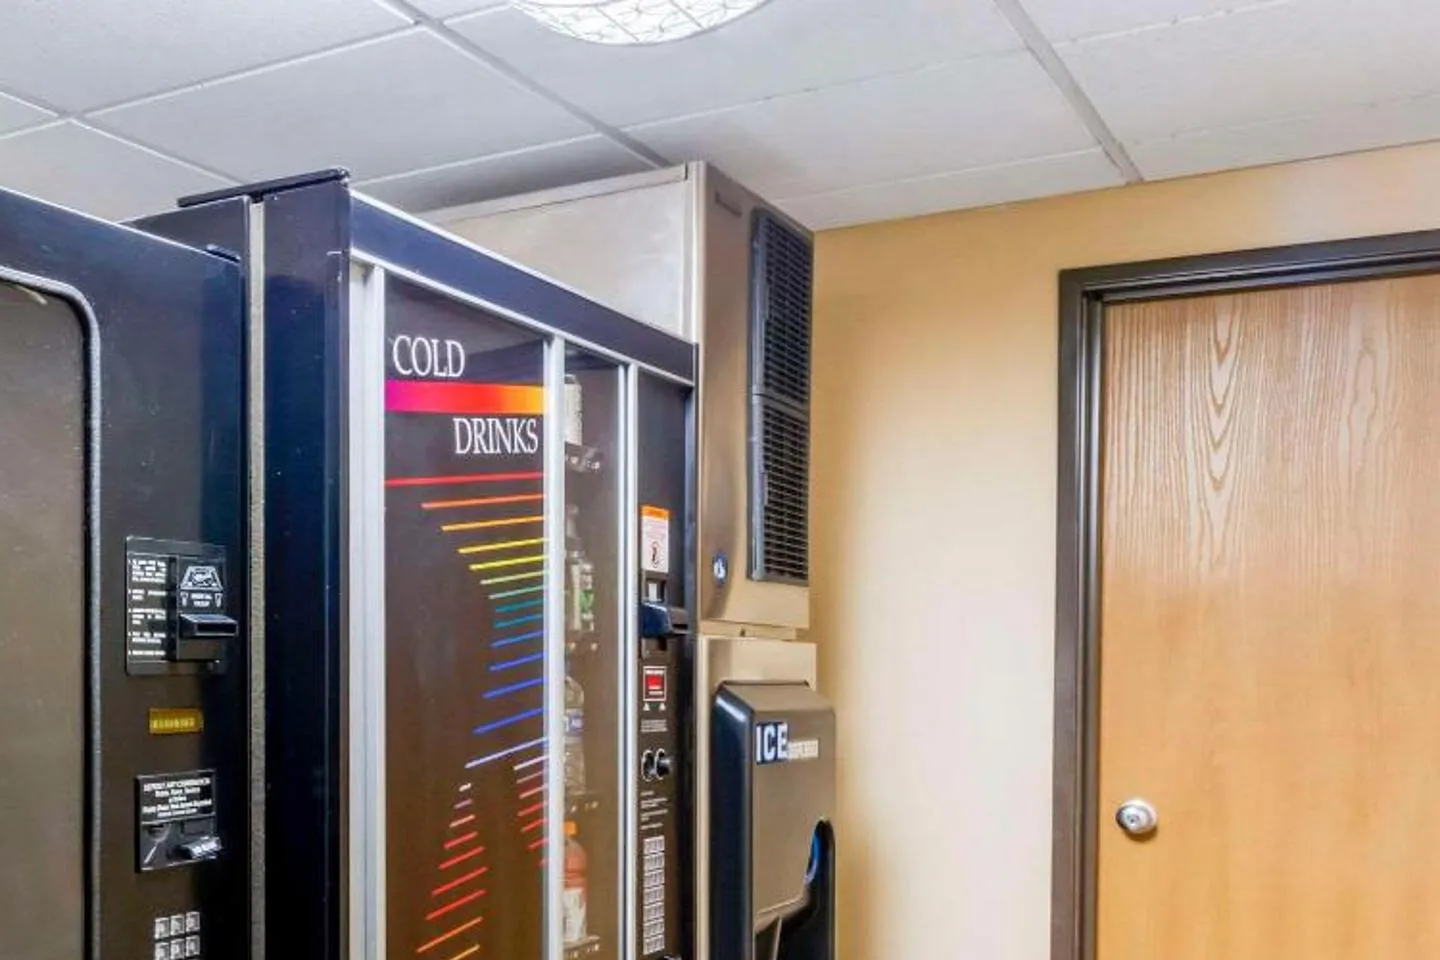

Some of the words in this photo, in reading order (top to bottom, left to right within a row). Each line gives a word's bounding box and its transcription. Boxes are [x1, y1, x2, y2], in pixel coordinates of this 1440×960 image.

[393, 335, 466, 378] COLD
[452, 417, 539, 455] DRINKS
[756, 723, 788, 762] ICE
